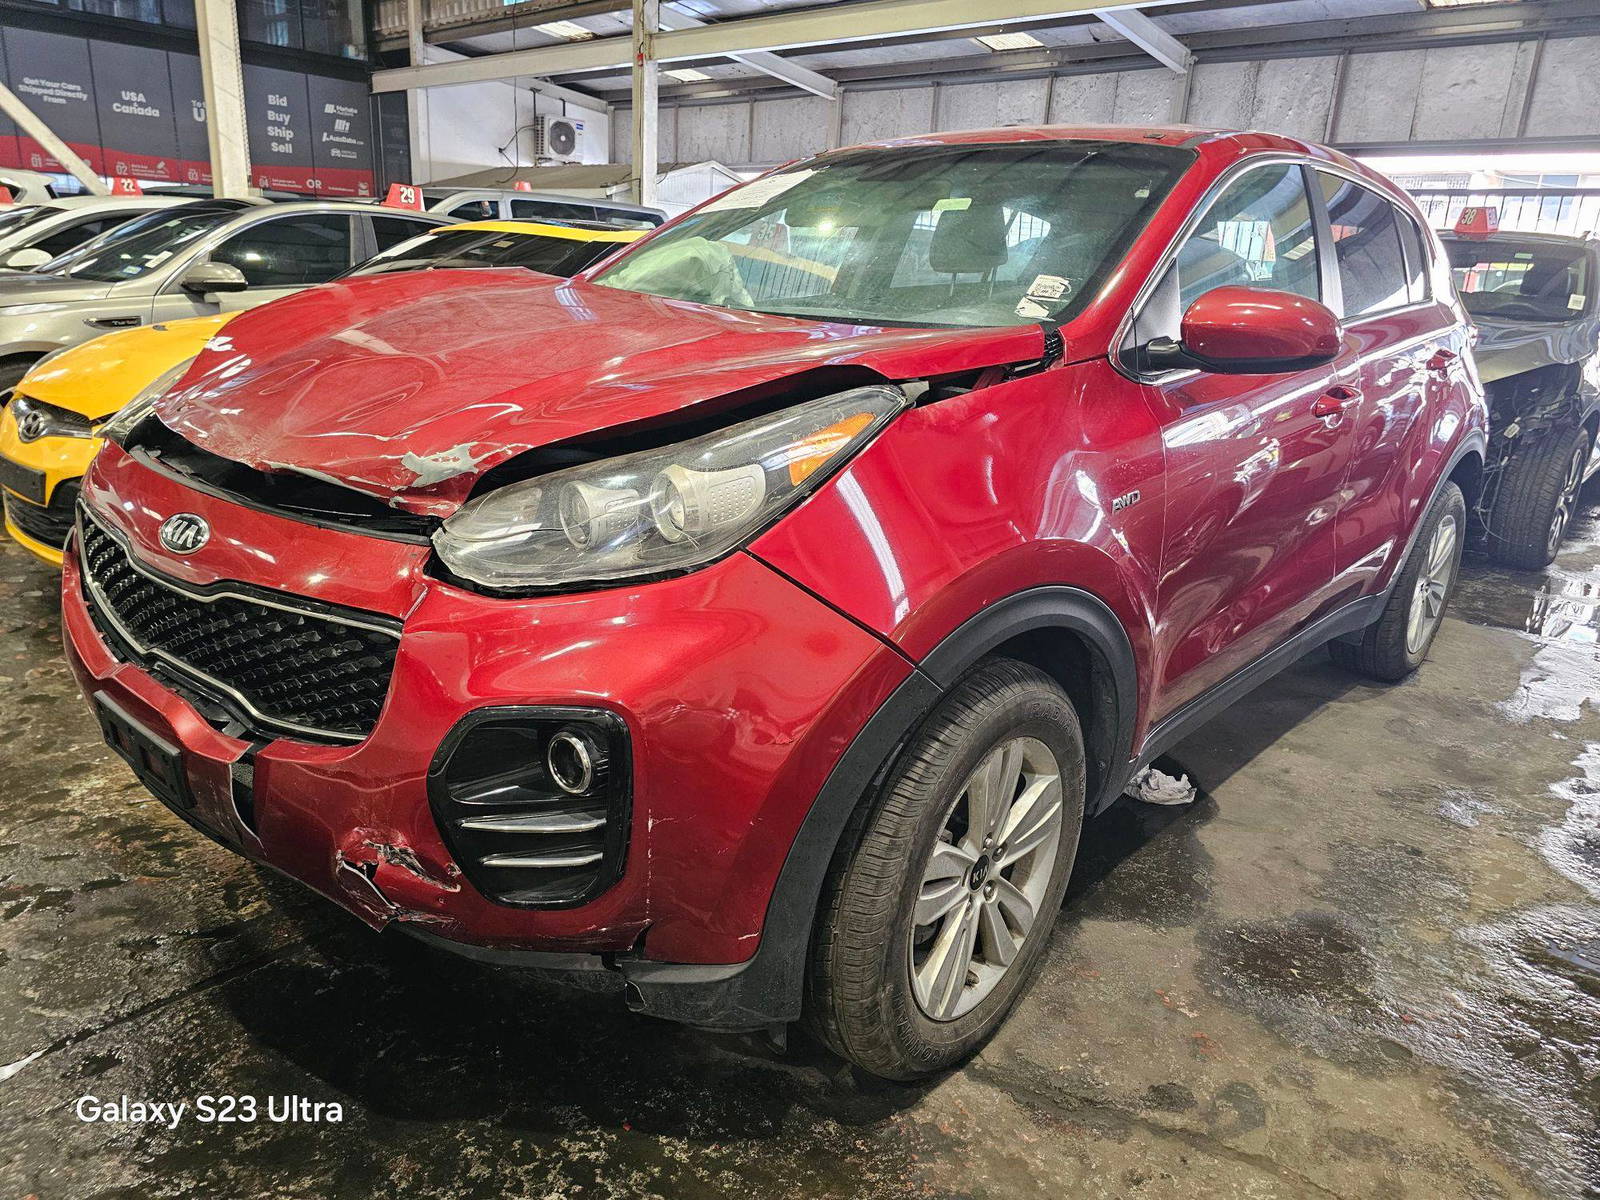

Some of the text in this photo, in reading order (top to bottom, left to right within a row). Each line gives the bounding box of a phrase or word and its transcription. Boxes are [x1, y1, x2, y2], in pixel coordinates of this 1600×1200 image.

[40, 80, 60, 88] Your
[18, 84, 88, 101] Shipped Directly
[121, 90, 146, 103] USA
[267, 94, 288, 107] Bid
[112, 103, 160, 117] Canada
[267, 110, 291, 125] Buy
[267, 126, 294, 141] Ship
[271, 142, 293, 153] Sell
[116, 164, 128, 175] 02
[121, 179, 136, 192] 22
[306, 179, 322, 189] OR
[400, 186, 415, 204] 29
[1461, 208, 1478, 225] 38
[1112, 489, 1141, 516] AWD
[163, 518, 199, 549] KIA
[973, 864, 988, 883] KIA
